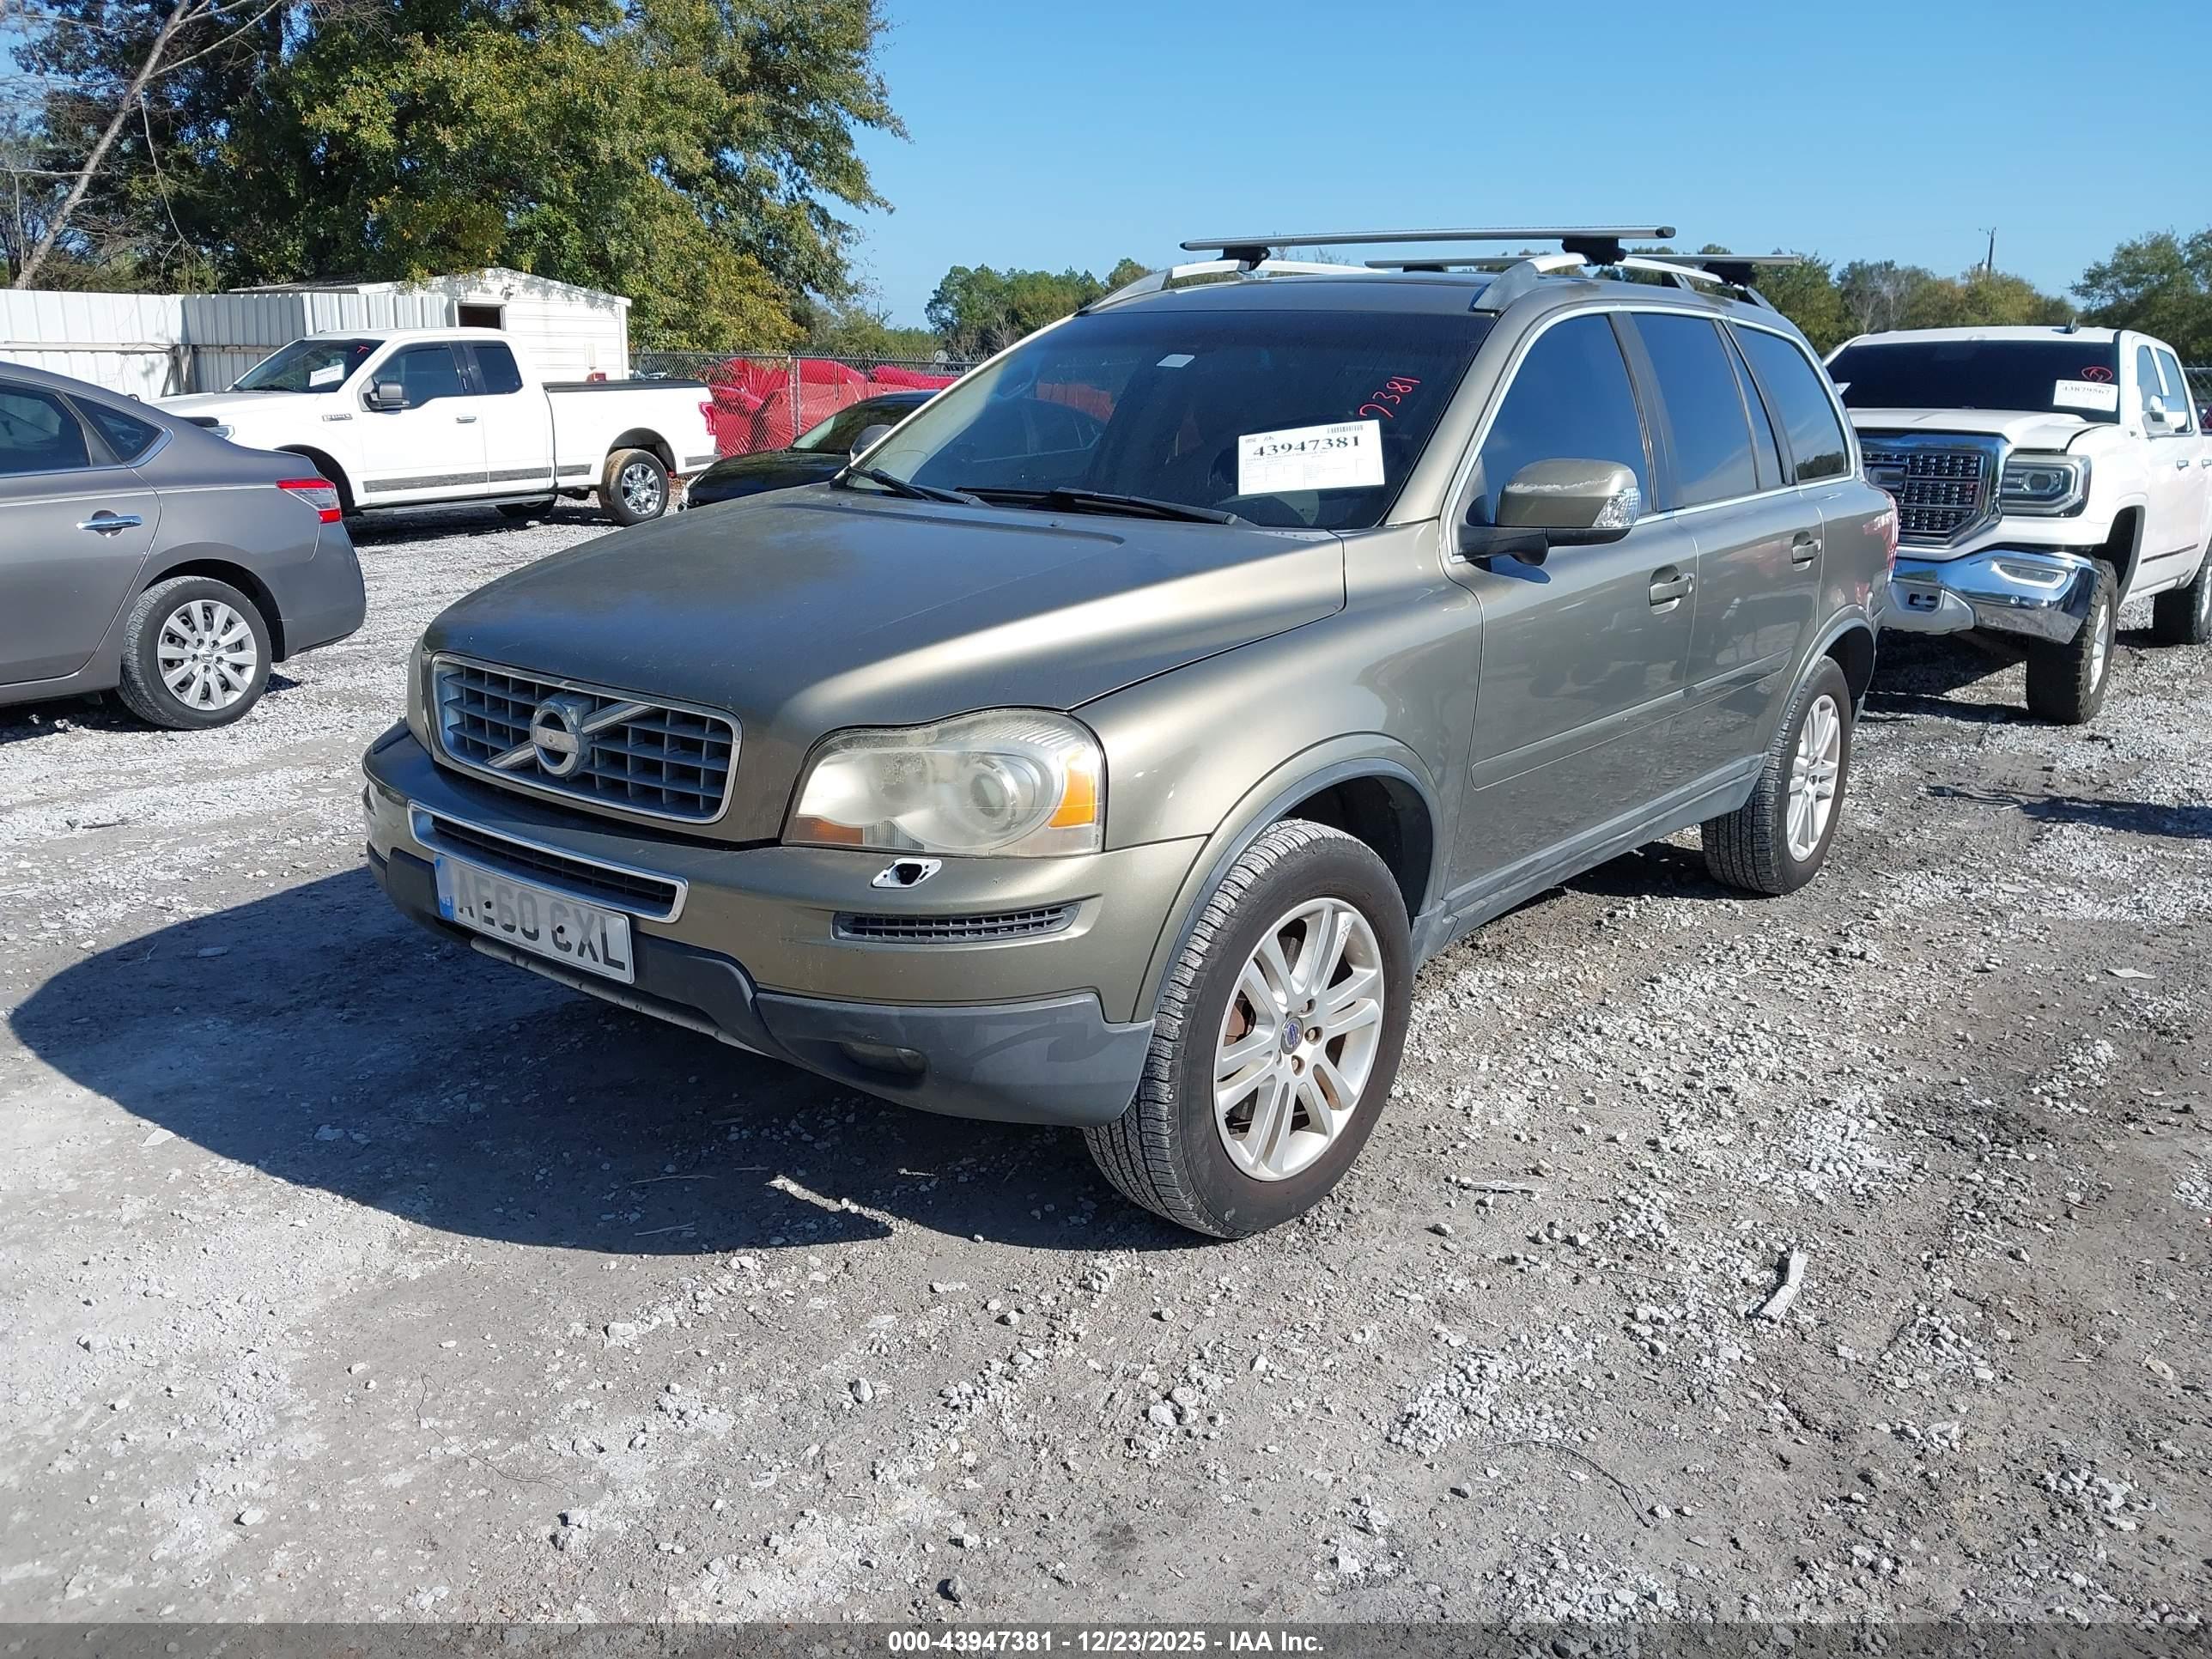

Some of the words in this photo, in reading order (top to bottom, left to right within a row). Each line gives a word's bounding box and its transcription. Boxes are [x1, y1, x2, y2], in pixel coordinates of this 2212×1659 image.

[1358, 375, 1421, 418] 7381
[1253, 435, 1360, 457] 43947381
[550, 900, 627, 971] CXL
